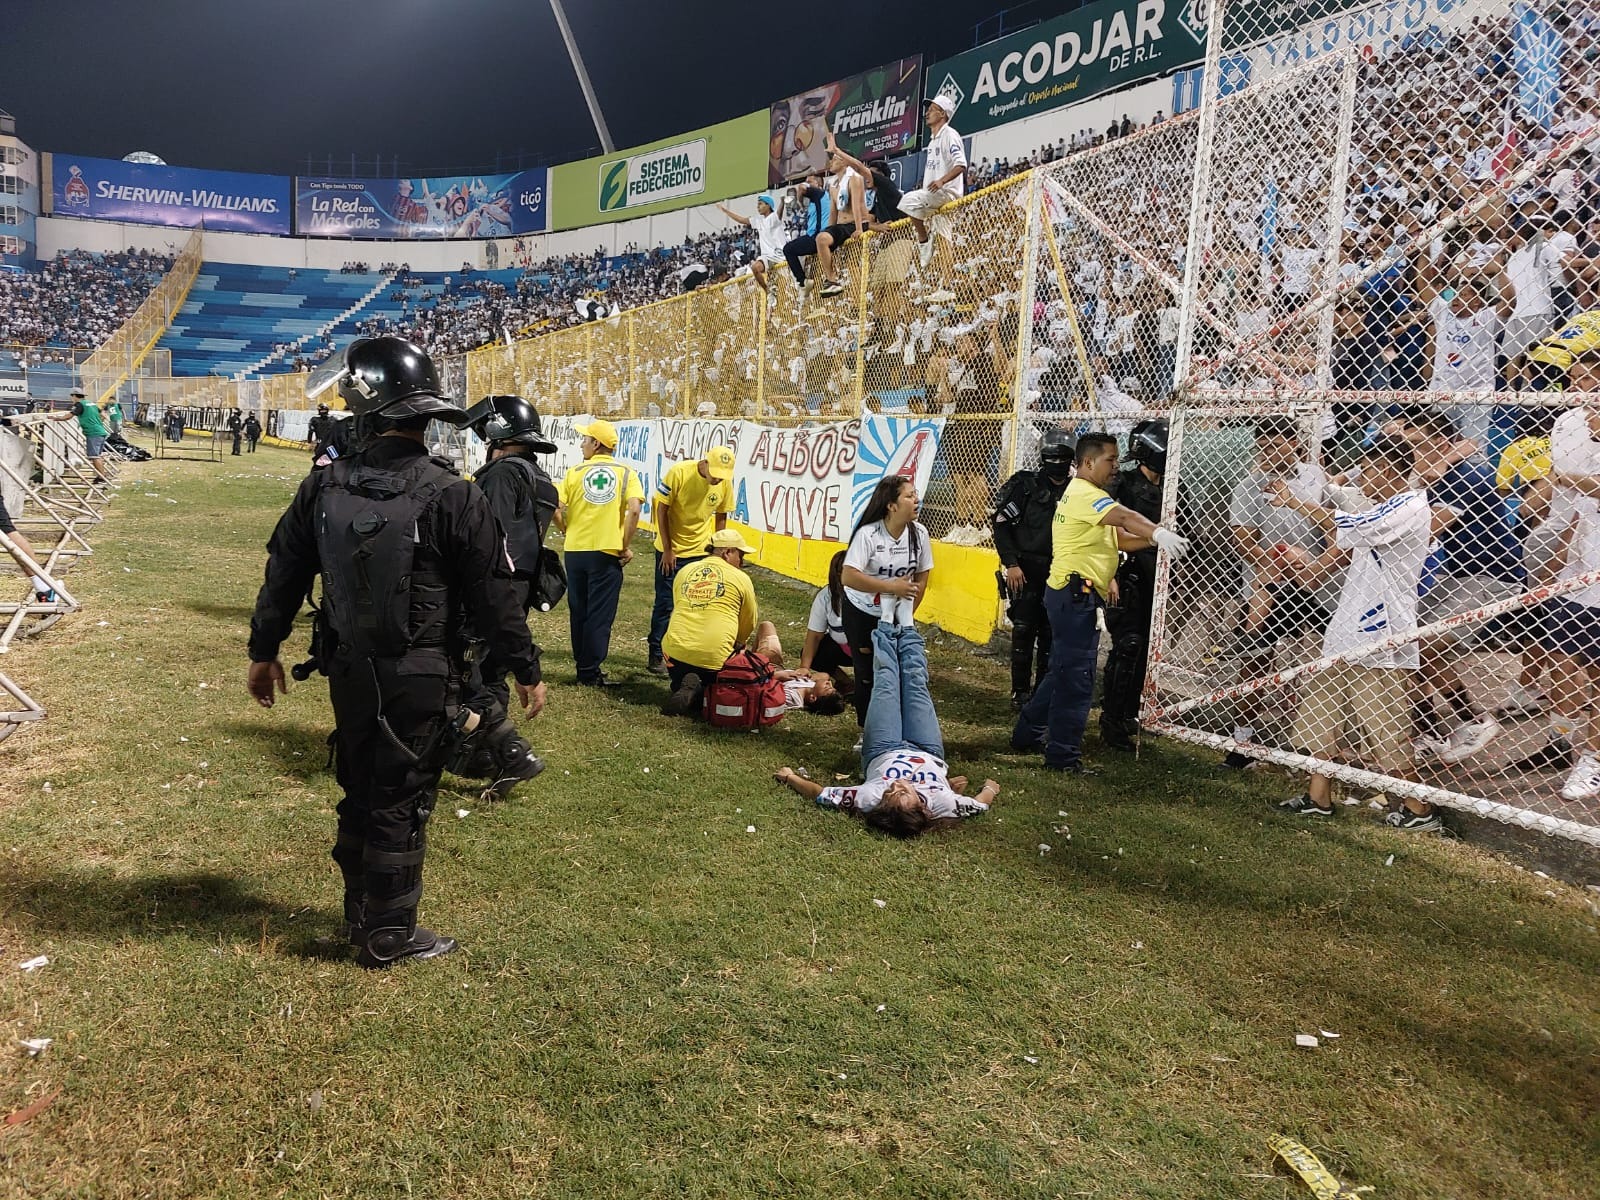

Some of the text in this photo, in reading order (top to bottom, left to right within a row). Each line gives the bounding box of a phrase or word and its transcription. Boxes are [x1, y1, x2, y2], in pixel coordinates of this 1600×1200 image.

[971, 0, 1166, 104] ACODJAR
[1109, 43, 1162, 72] DE R.L.
[833, 95, 906, 134] Franklin
[846, 101, 873, 115] ÓPTICAS
[640, 153, 690, 178] SISTEMA
[629, 166, 701, 196] FEDECREDITO
[311, 196, 330, 212] La
[332, 196, 359, 213] Red
[310, 212, 381, 229] Más Goles
[618, 425, 650, 462] POPULAR
[661, 418, 862, 480] VAMOS ALBOS
[760, 480, 841, 542] VIVE
